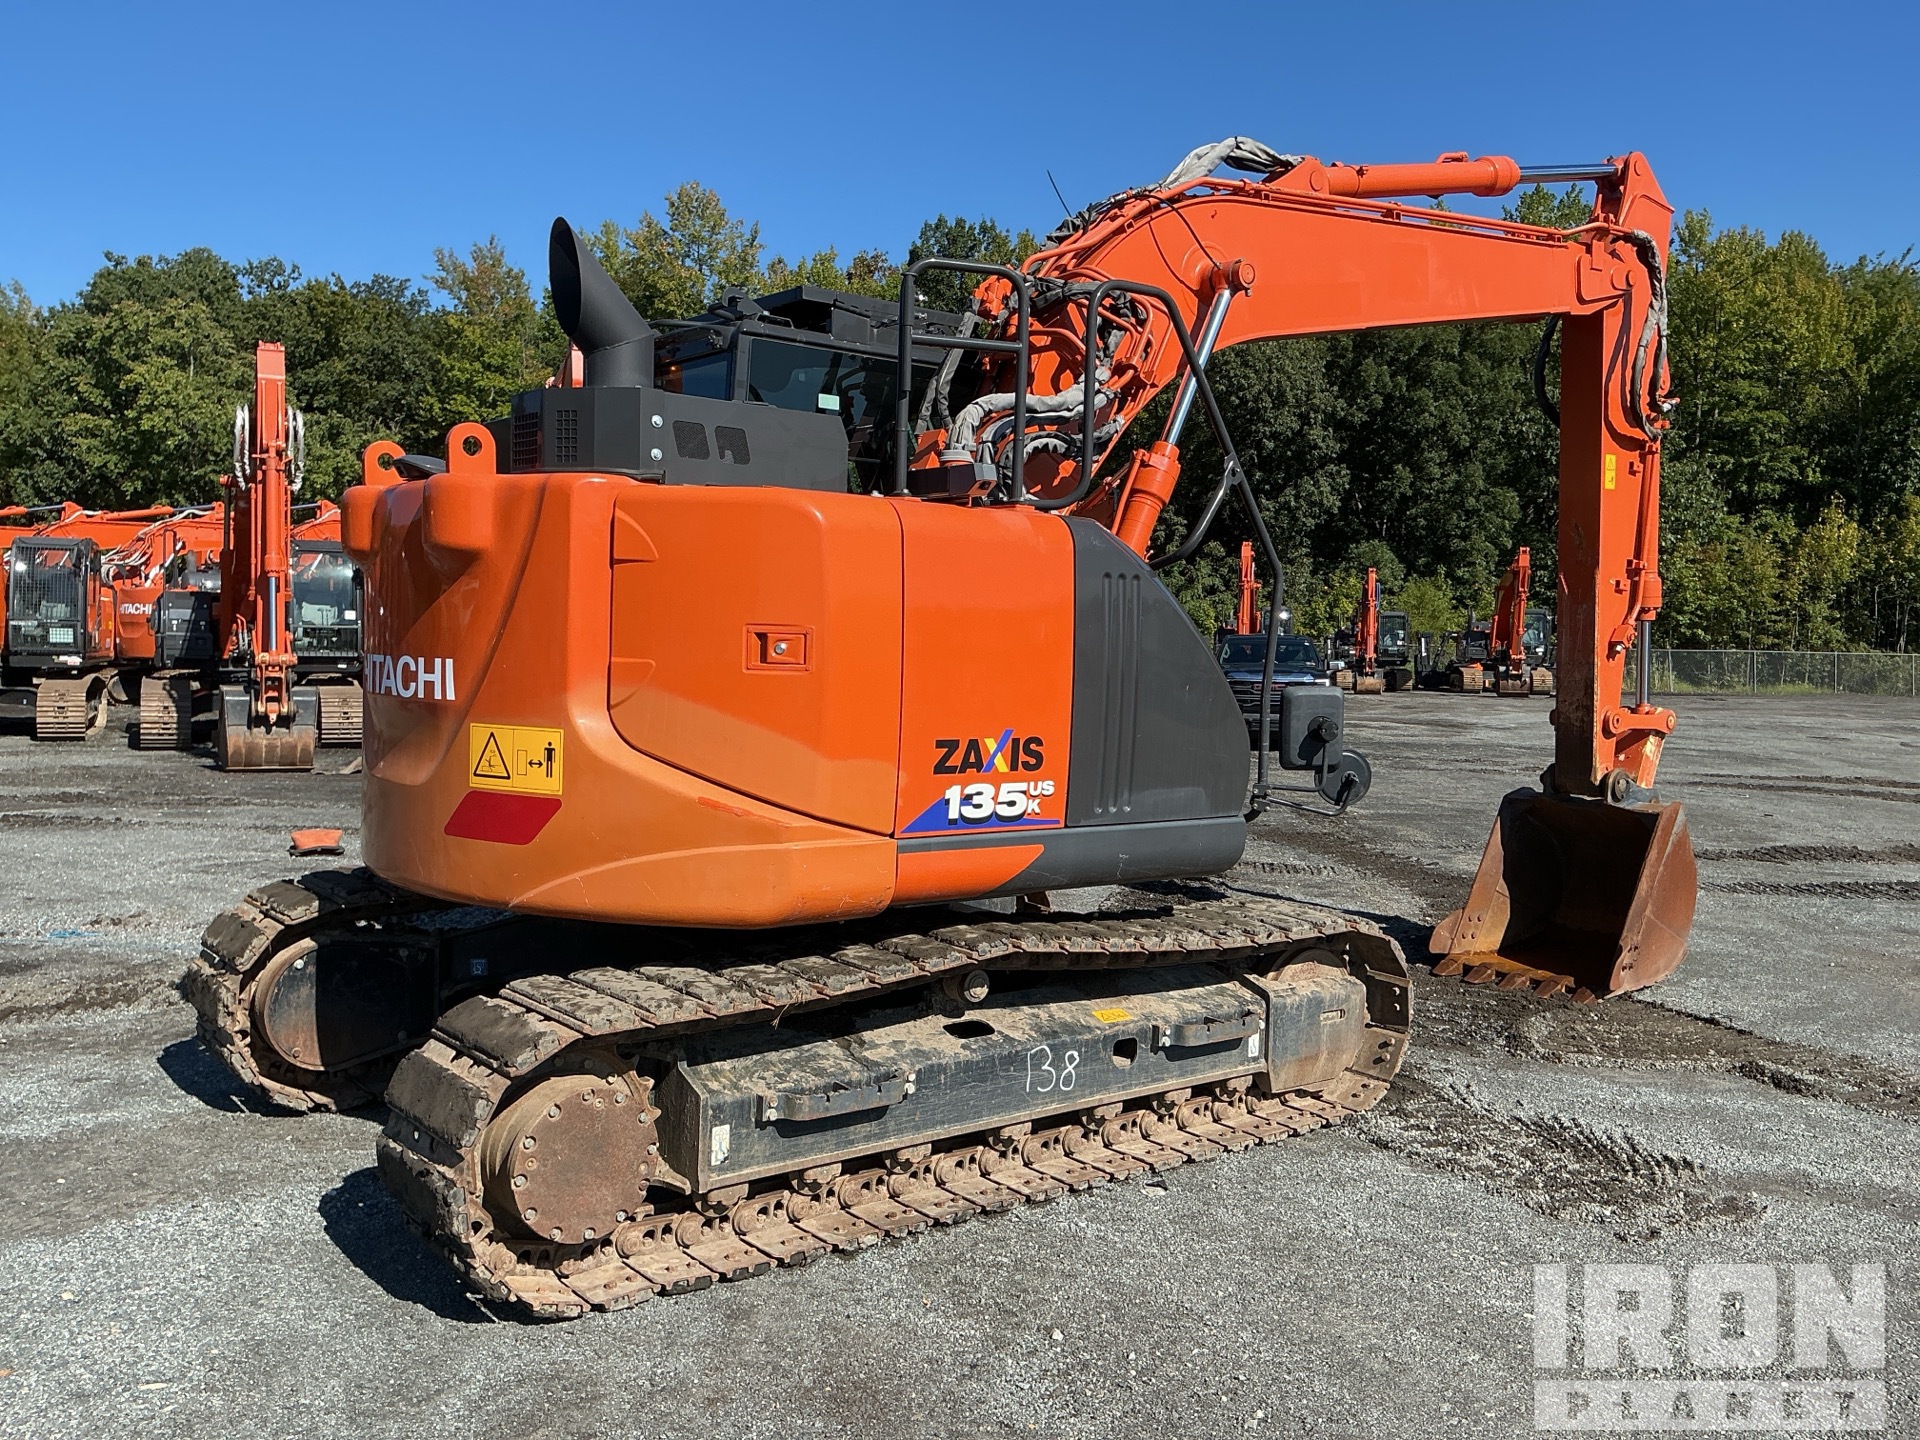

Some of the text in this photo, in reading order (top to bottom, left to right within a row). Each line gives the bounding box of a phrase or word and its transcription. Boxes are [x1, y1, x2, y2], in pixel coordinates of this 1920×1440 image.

[933, 729, 1044, 774] ZAXIS
[945, 781, 1055, 825] 135 US
